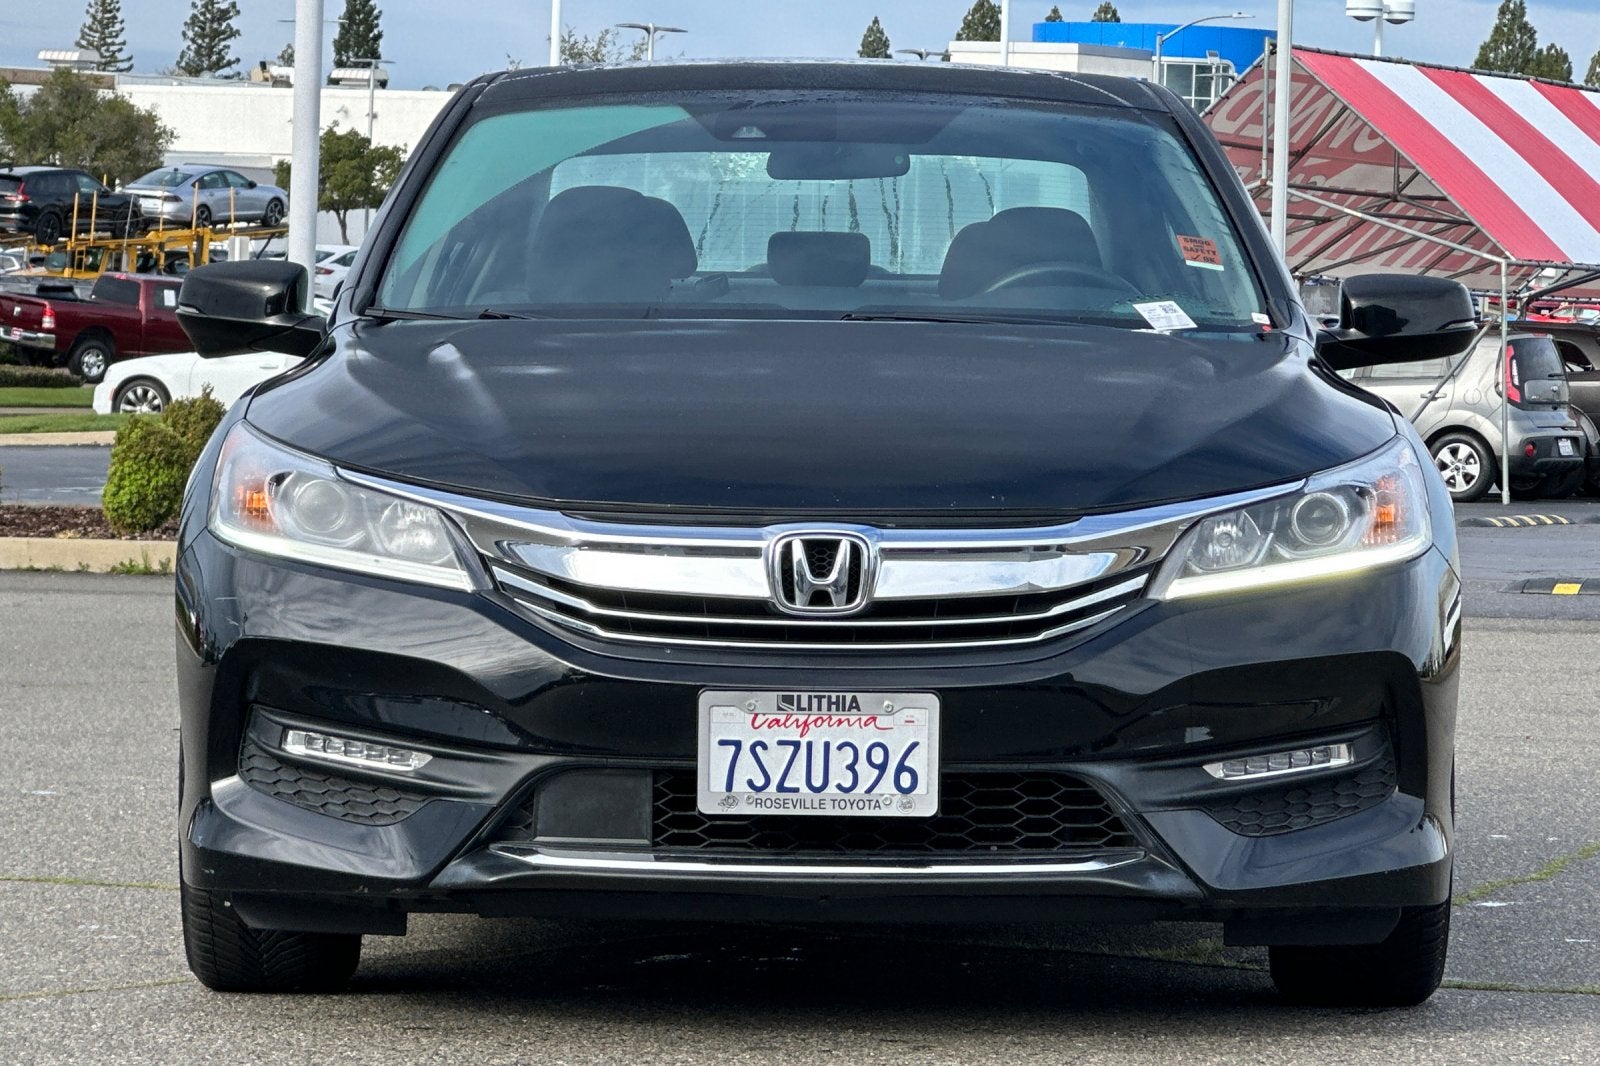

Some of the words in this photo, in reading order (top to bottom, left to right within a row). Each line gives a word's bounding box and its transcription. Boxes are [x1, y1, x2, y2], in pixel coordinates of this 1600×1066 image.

[796, 694, 861, 712] LITHIA
[751, 713, 894, 738] California
[717, 739, 920, 795] 7SZU396
[754, 797, 826, 810] ROSEVILLE
[831, 798, 882, 811] TOYOTA
